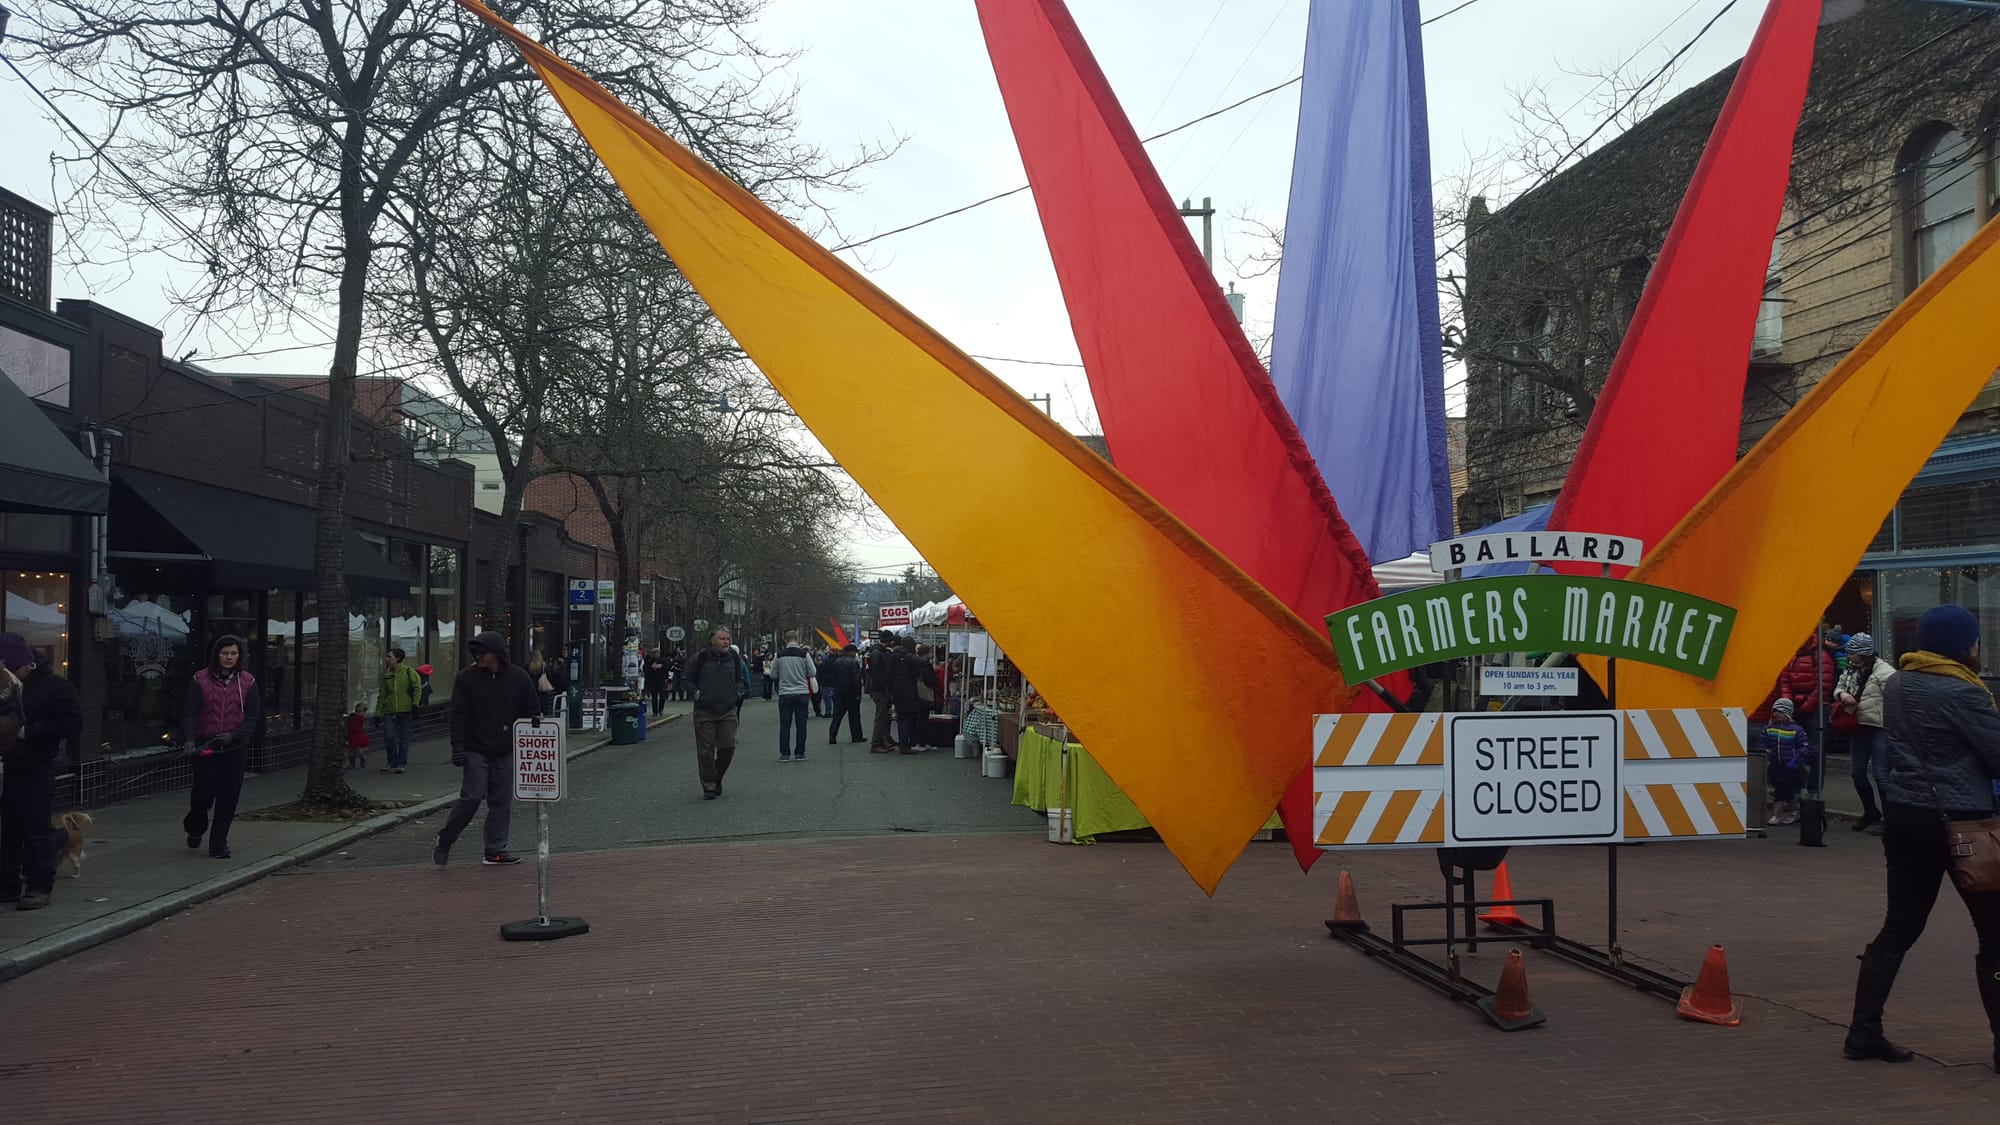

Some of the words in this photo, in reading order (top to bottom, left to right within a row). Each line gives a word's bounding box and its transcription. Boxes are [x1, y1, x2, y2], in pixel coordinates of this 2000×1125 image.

[1449, 535, 1625, 565] BALLARD
[881, 608, 908, 617] EGGS
[1346, 586, 1529, 671] FARMERS
[1562, 586, 1723, 666] MARKET
[572, 648, 579, 656] P
[1484, 670, 1504, 678] OPEN
[1506, 671, 1540, 679] SUNDAYS
[1503, 682, 1512, 690] 10
[518, 738, 556, 748] SHORT
[520, 750, 555, 760] LEASH
[1475, 735, 1600, 771] STREET
[520, 761, 532, 771] AT
[535, 762, 556, 772] ALL
[520, 773, 555, 784] TIMES
[1473, 780, 1601, 815] CLOSED
